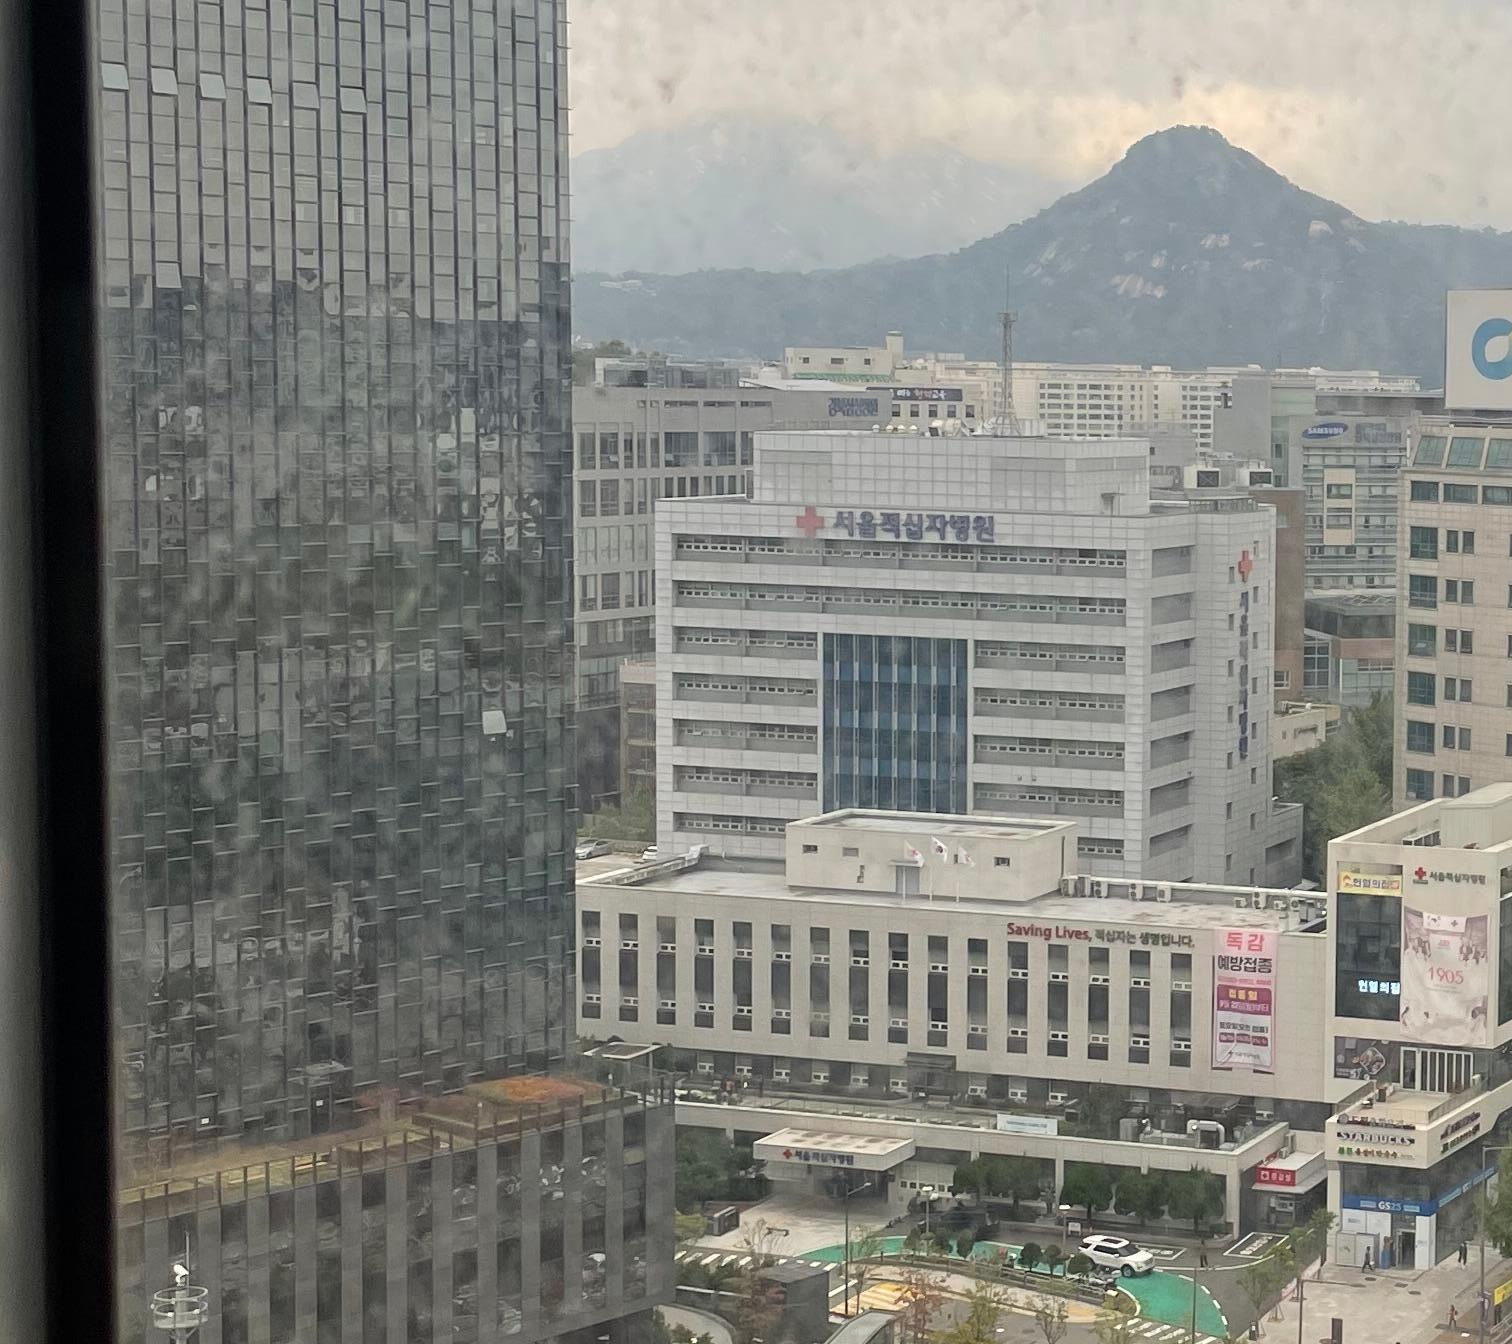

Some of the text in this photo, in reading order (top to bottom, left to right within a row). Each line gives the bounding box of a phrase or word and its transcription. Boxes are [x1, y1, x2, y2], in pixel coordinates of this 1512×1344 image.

[833, 510, 995, 544] 서울적십자병원
[1007, 922, 1195, 948] Saving Lives, 적십자는 생명입니다.
[1217, 954, 1273, 974] 예방접종
[1428, 966, 1464, 985] 1905
[1338, 1131, 1414, 1146] STARBUCKS
[1378, 1200, 1402, 1210] GS25
